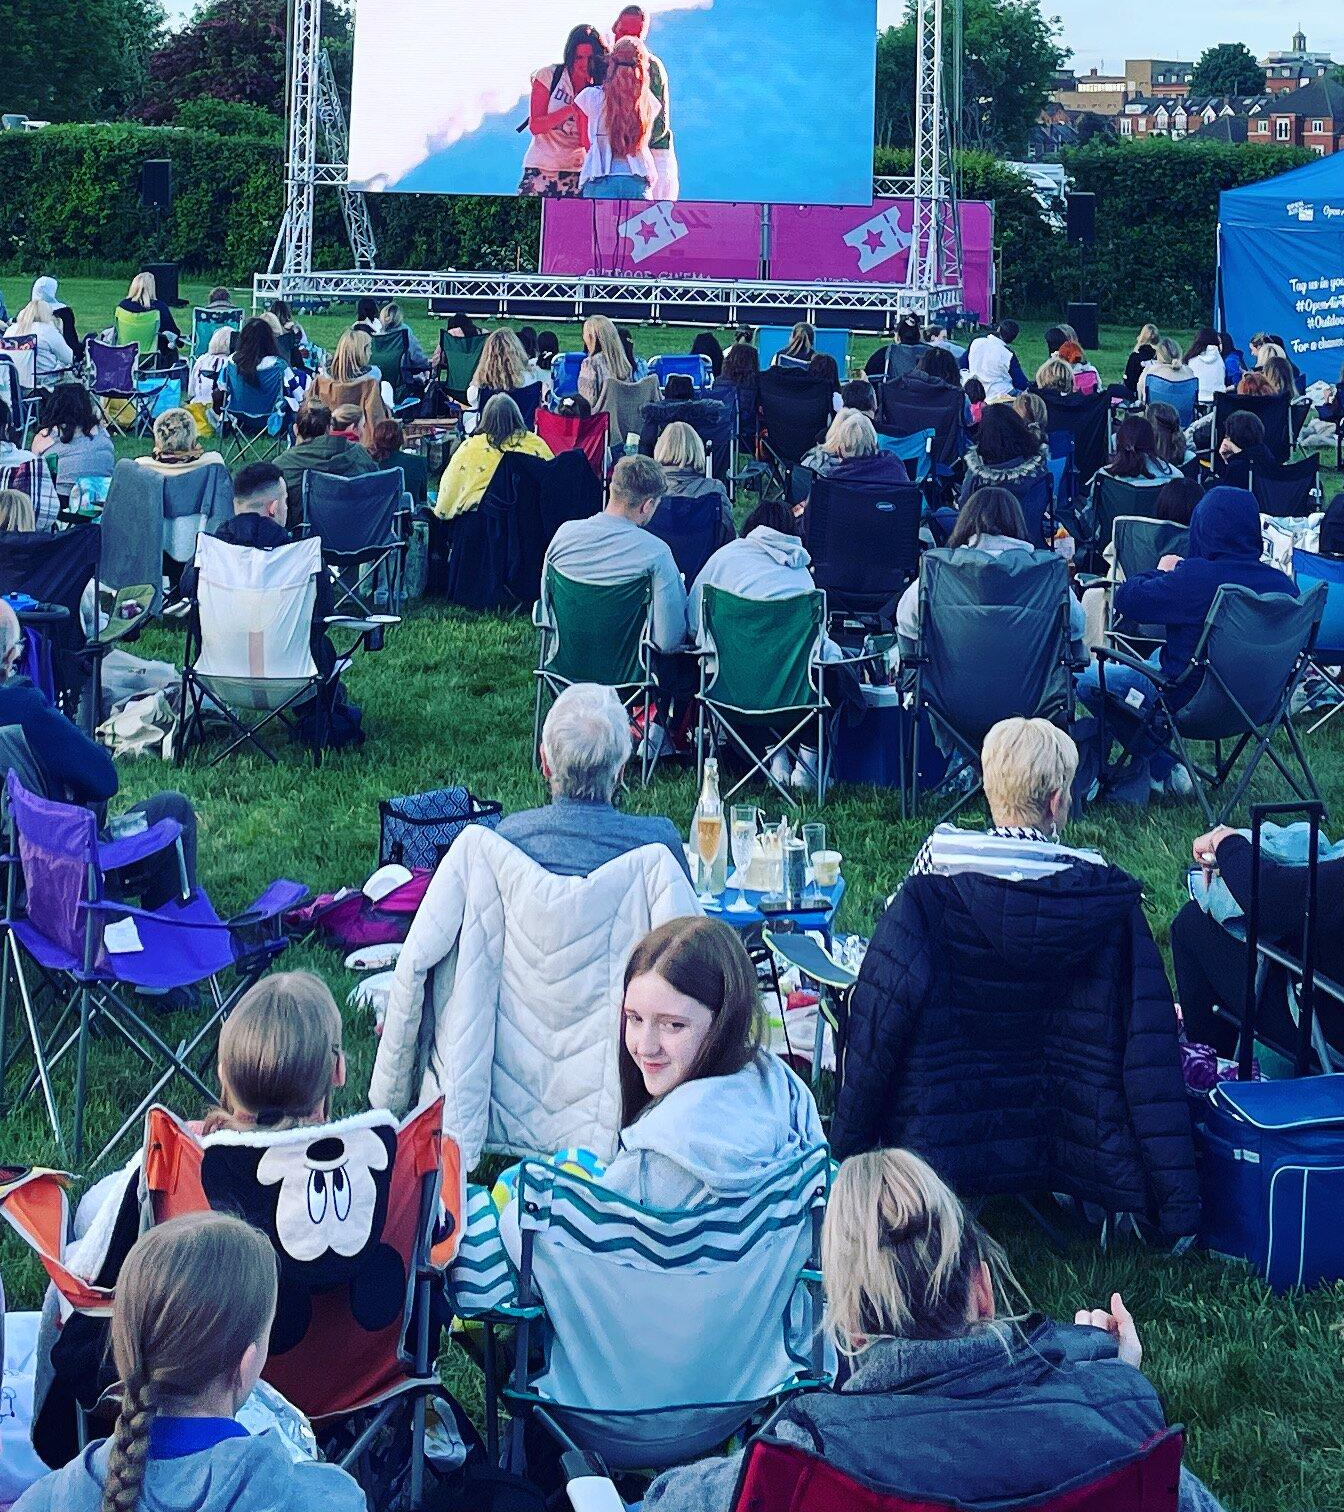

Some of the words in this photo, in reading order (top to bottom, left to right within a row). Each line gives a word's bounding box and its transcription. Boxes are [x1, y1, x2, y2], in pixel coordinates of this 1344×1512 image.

[1289, 277, 1307, 296] Tag
[1308, 279, 1319, 290] us
[1320, 275, 1330, 289] in
[1290, 338, 1310, 354] For
[1310, 341, 1318, 351] a
